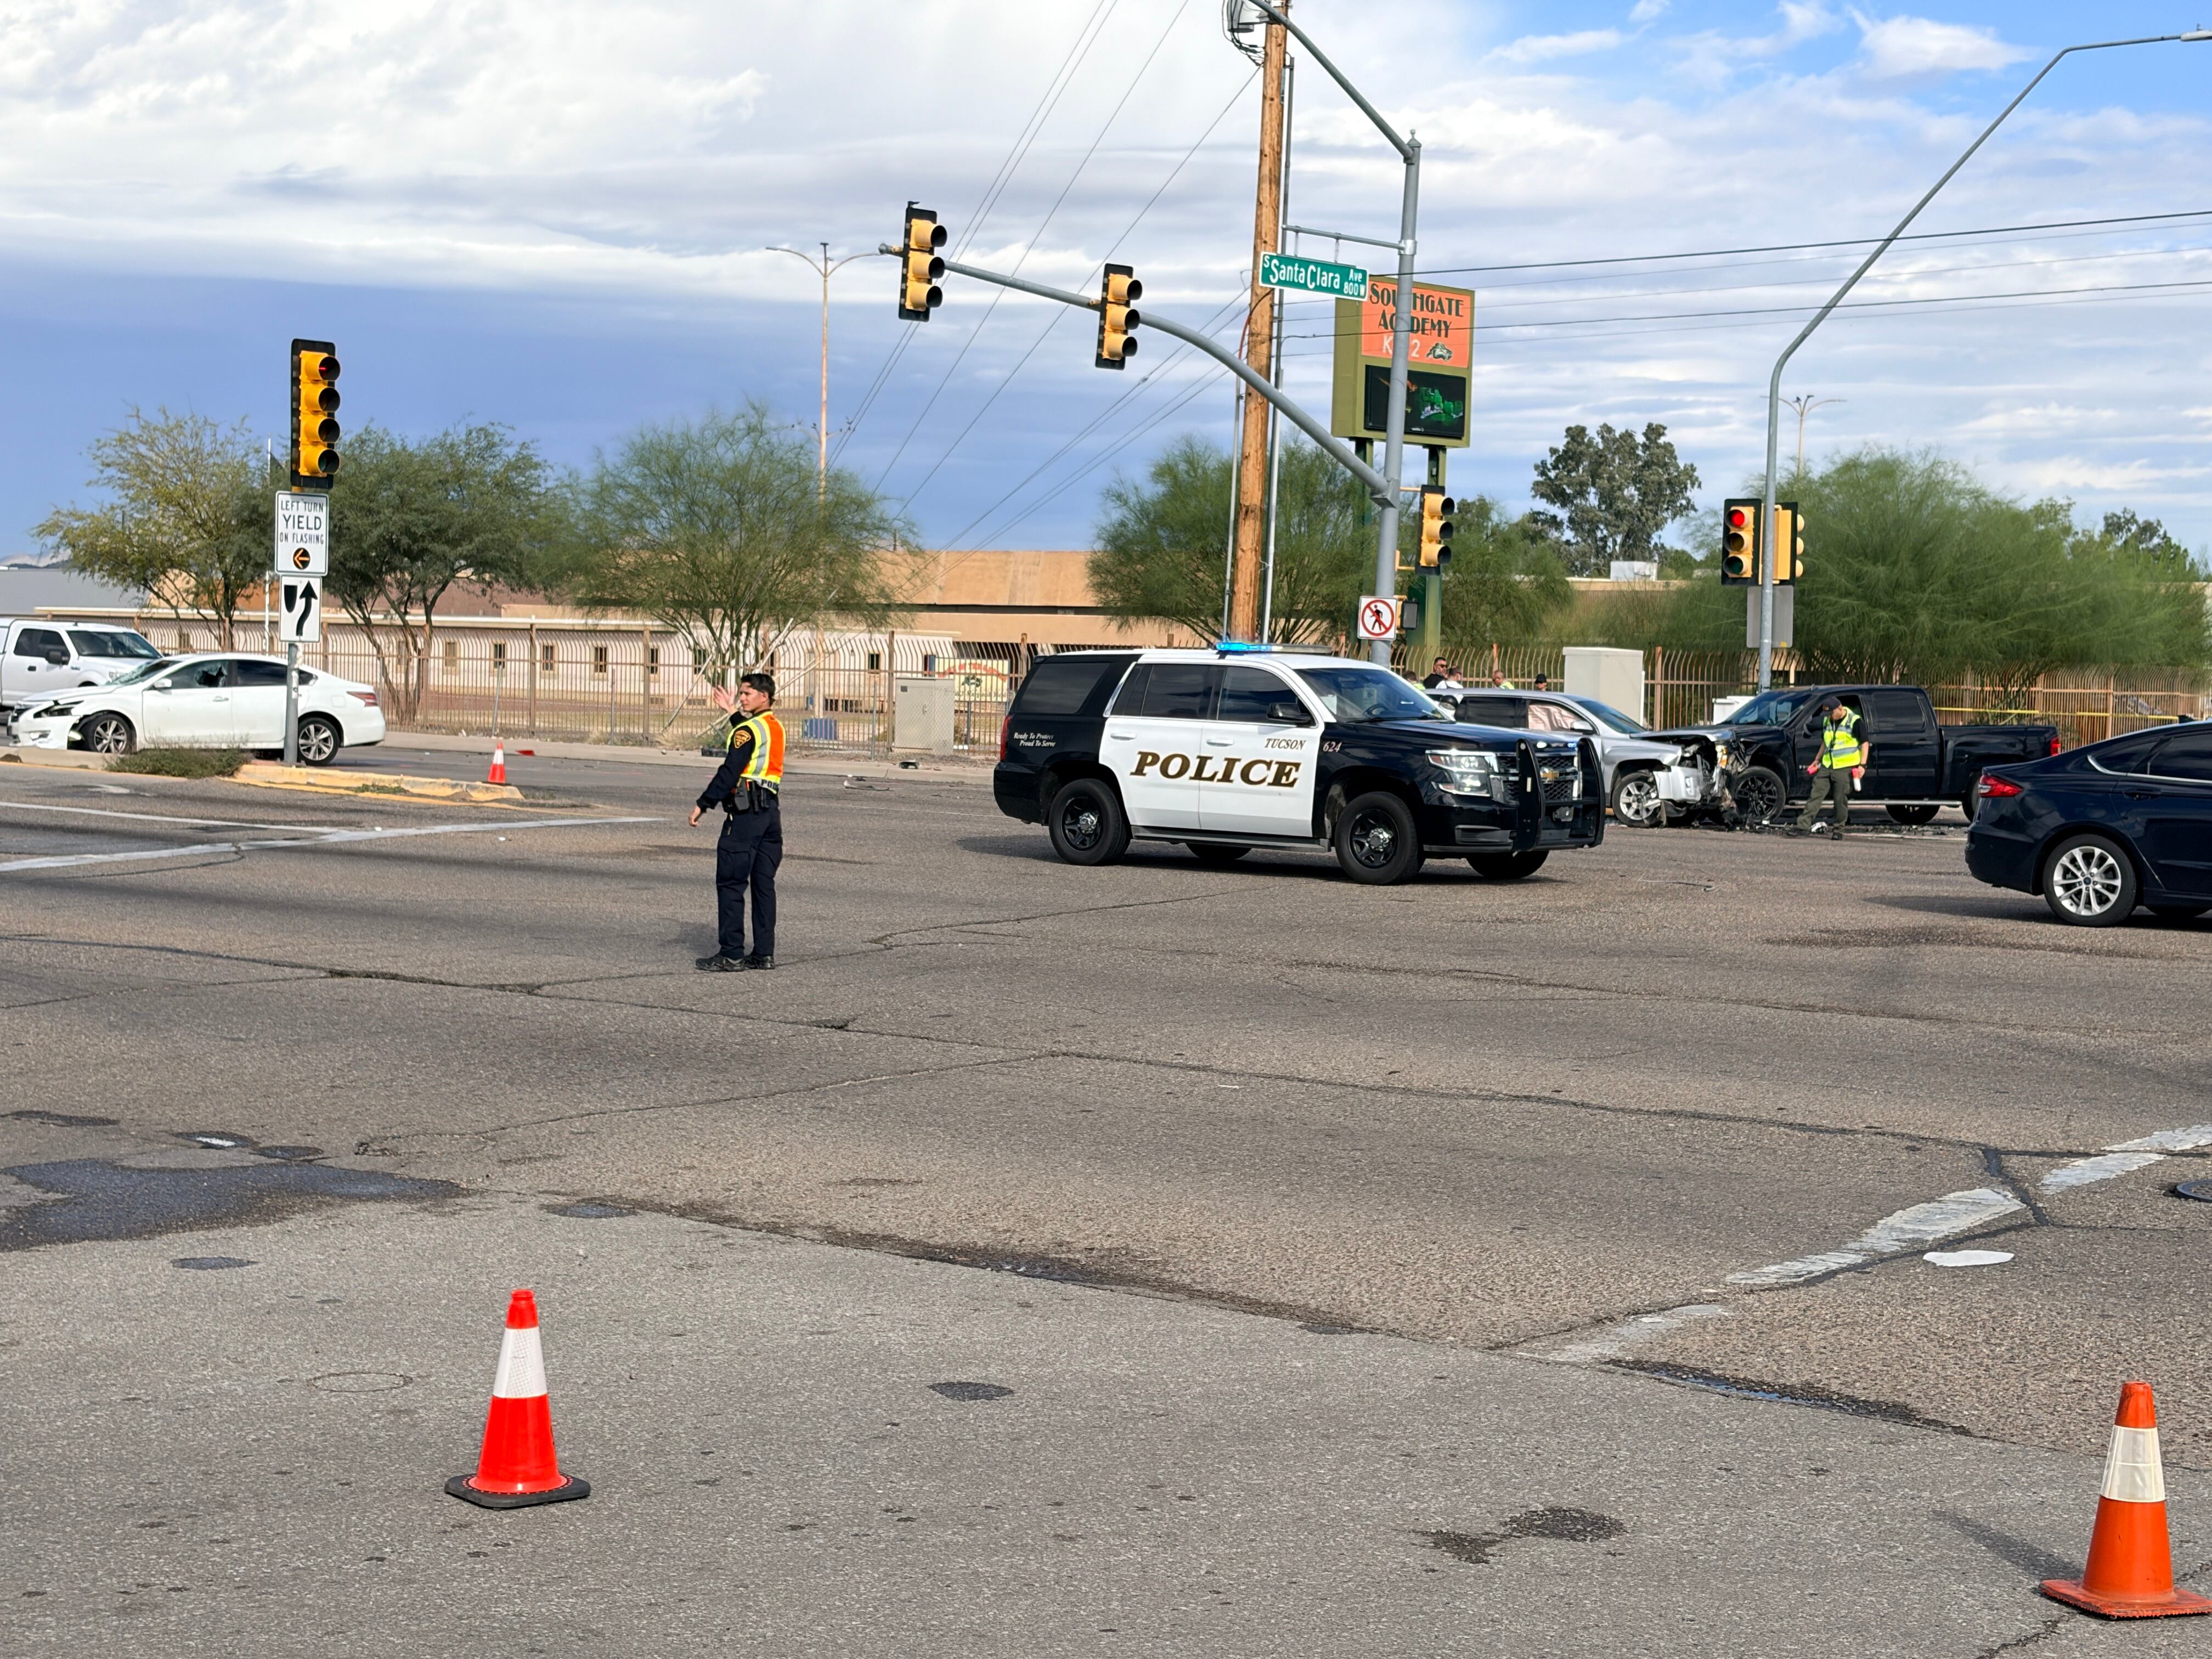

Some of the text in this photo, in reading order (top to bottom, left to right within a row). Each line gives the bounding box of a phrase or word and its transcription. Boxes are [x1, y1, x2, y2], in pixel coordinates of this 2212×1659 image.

[1263, 256, 1363, 289] S Santa Clara Ave
[1344, 281, 1359, 296] 800
[1369, 283, 1464, 317] SOUHGATE
[1378, 309, 1452, 338] ACDEMY
[281, 500, 324, 512] LEFT TURN
[283, 514, 322, 531] YIELD
[280, 532, 324, 545] ON FLASHING
[1013, 732, 1029, 741] Ready
[1264, 738, 1306, 750] TUCSON
[1323, 741, 1342, 752] 624
[1129, 751, 1302, 788] POLICE
